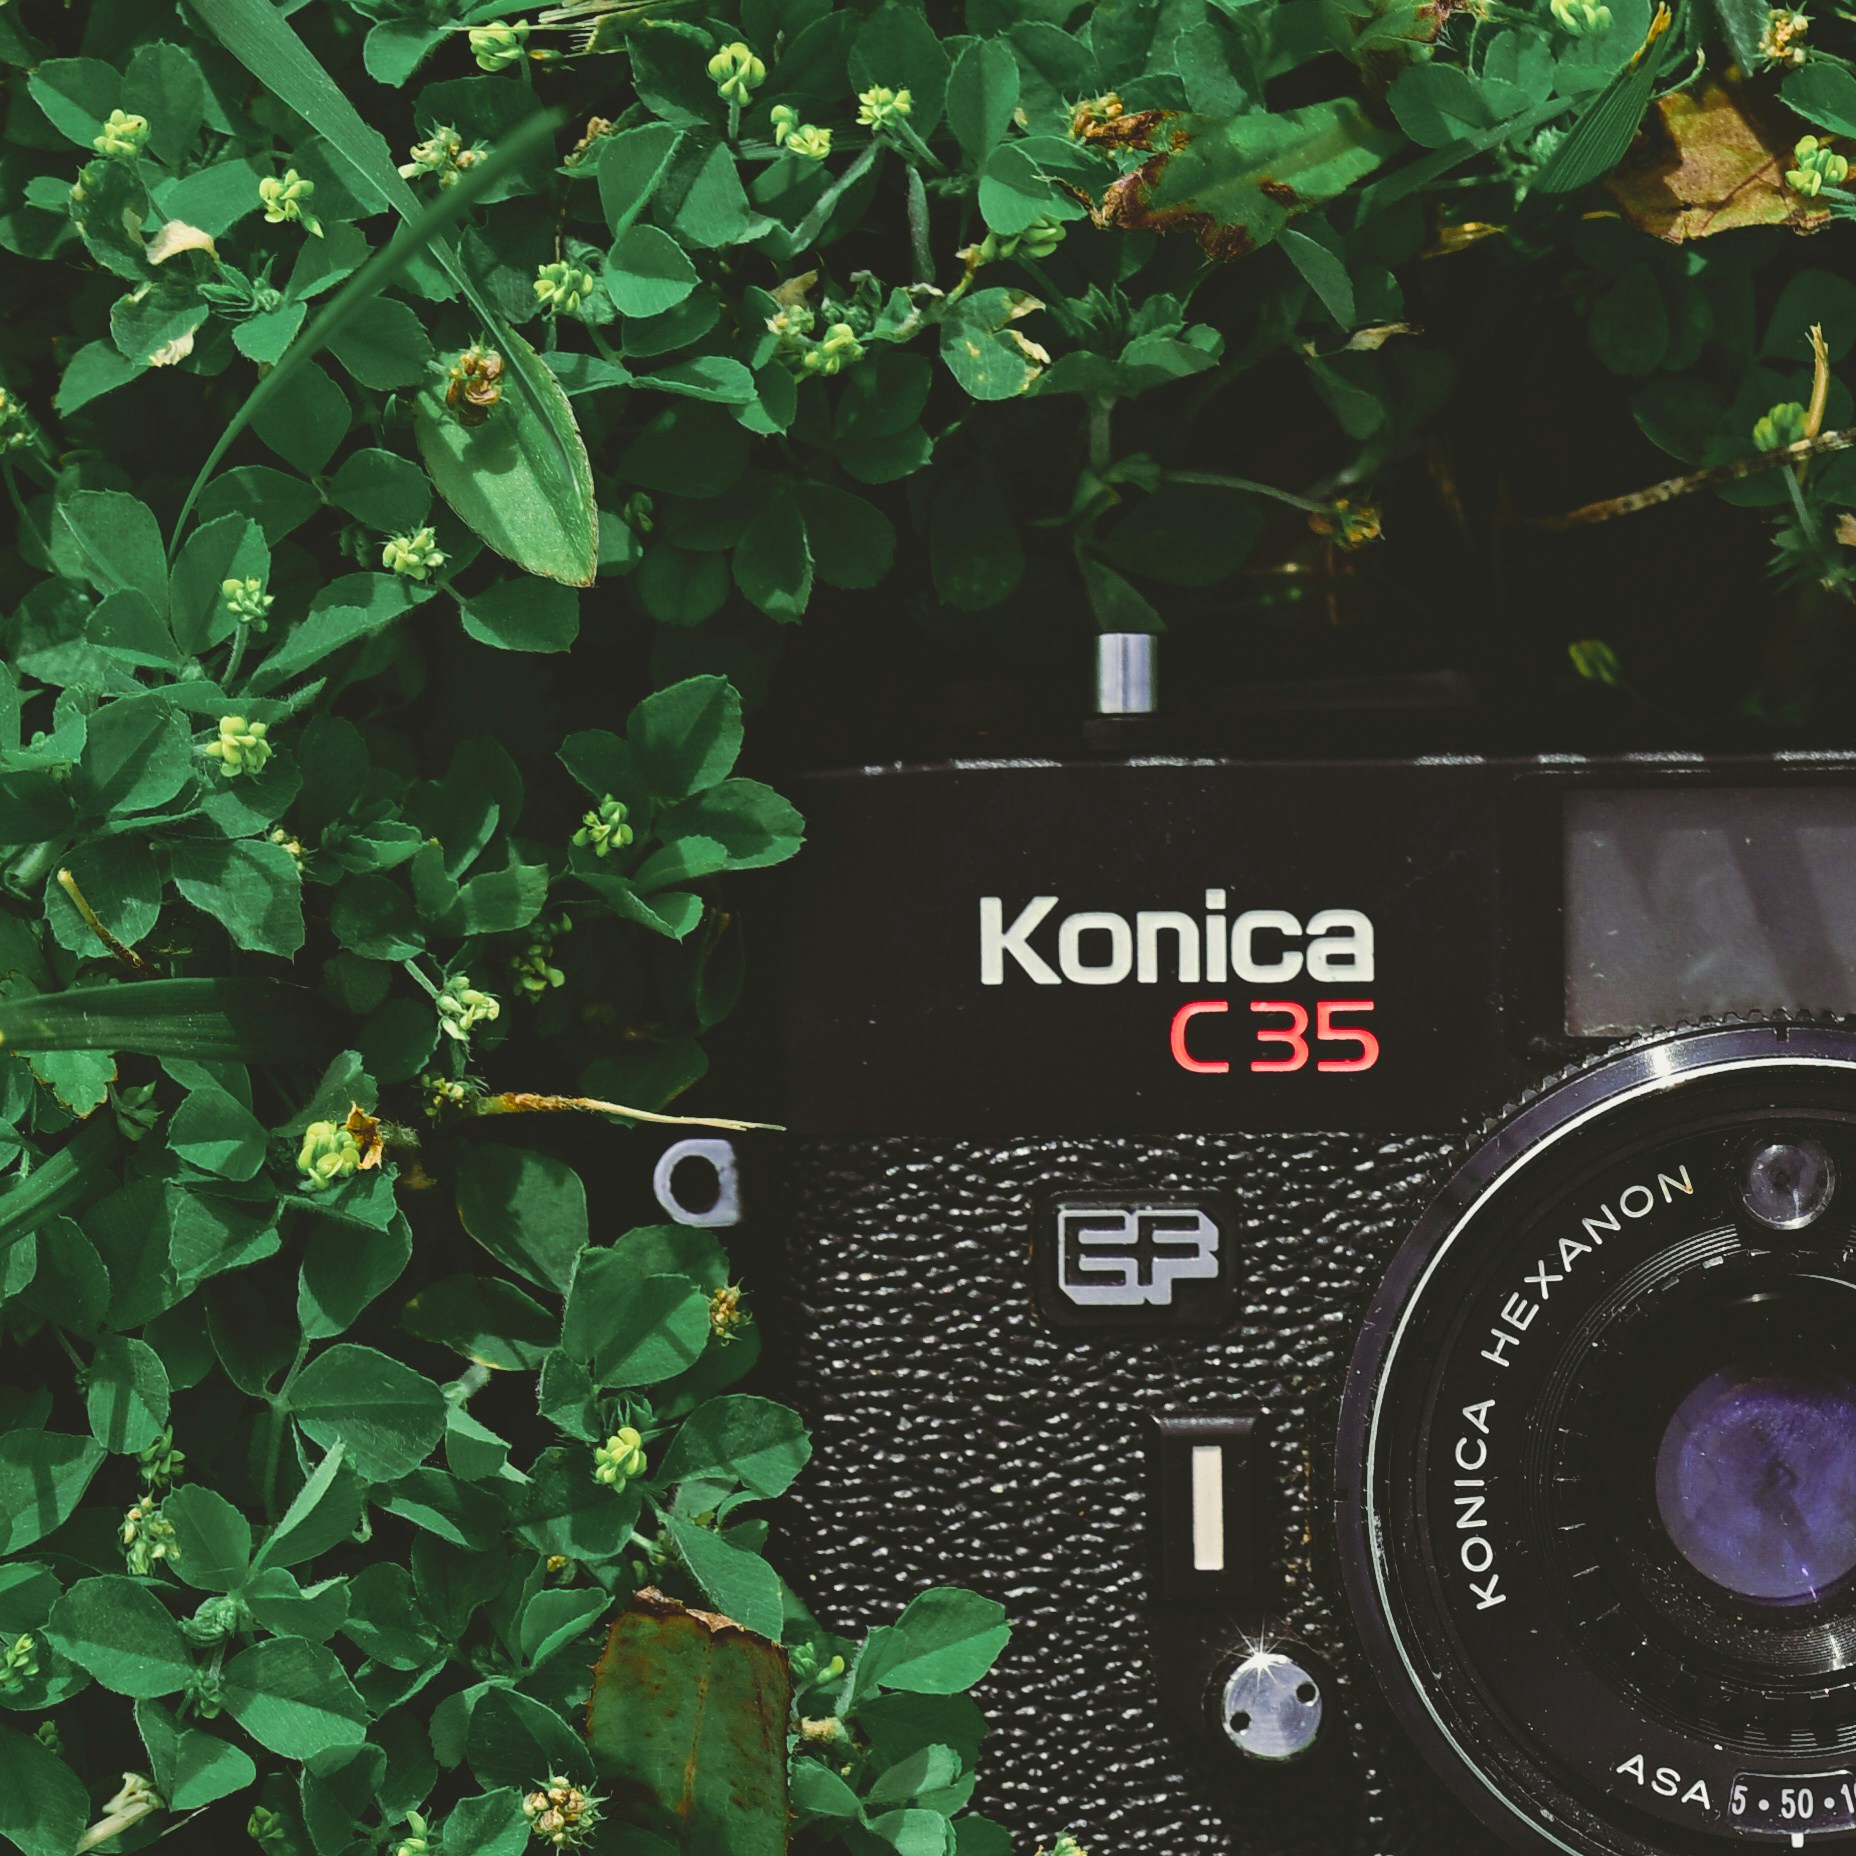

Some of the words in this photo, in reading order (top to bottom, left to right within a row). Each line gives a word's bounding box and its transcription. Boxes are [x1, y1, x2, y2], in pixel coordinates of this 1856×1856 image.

[980, 889, 1375, 985] Konica
[1454, 1399, 1506, 1610] KONICA
[1480, 1165, 1695, 1368] HEXANON
[1616, 1754, 1712, 1810] ASA
